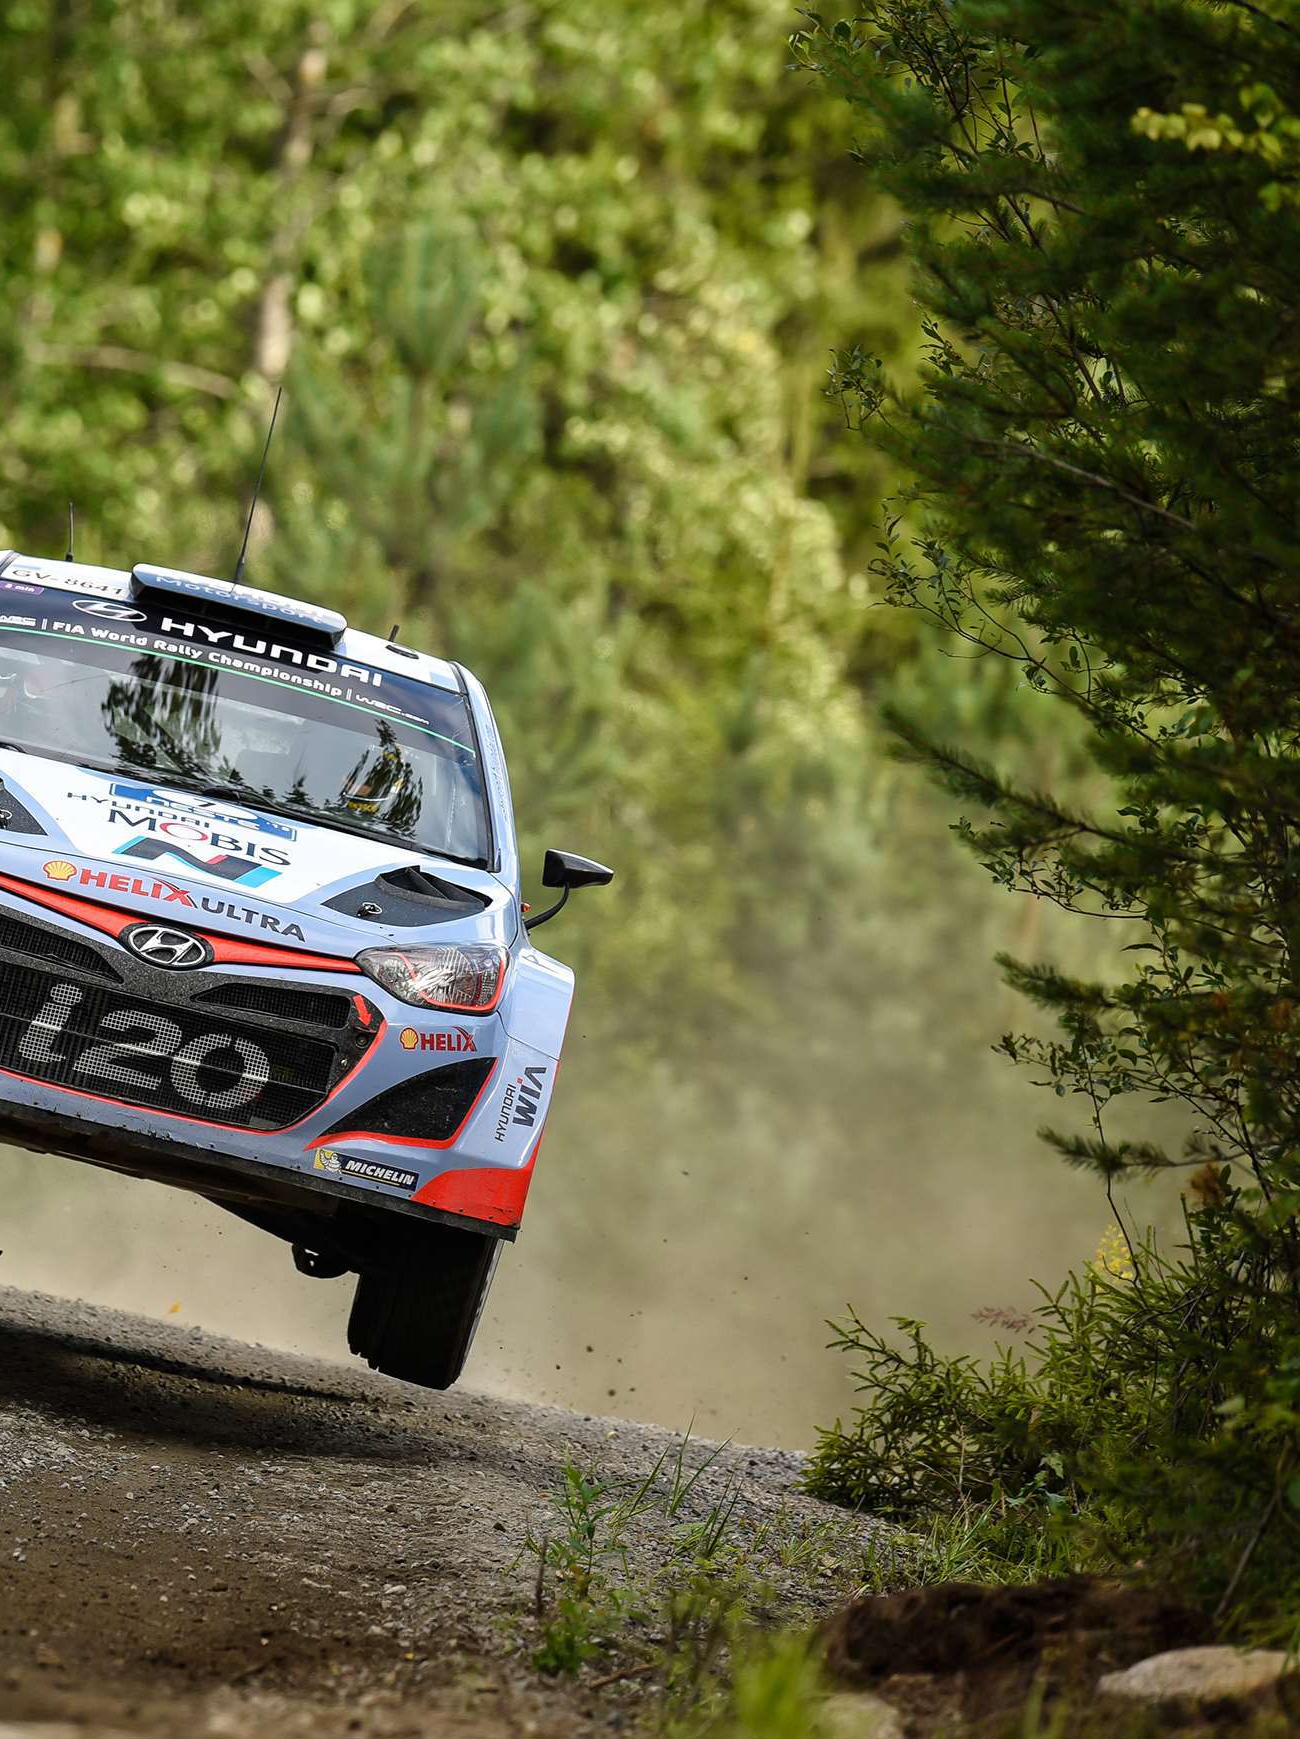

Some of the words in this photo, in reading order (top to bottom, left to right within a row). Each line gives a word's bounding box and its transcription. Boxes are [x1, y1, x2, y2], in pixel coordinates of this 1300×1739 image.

[52, 621, 85, 635] FIA
[90, 626, 148, 646] World
[153, 639, 204, 659] Rally
[208, 651, 342, 697] Championship
[161, 617, 382, 687] HYUNDAI
[67, 791, 210, 829] HYUNDAI
[108, 808, 292, 866] MOBIS
[79, 868, 198, 909] HELIX
[201, 896, 306, 943] ULTRA
[18, 983, 270, 1110] i20
[419, 1026, 477, 1052] HELIX
[494, 1083, 517, 1143] HYUNDAI
[512, 1066, 547, 1127] WIA
[345, 1160, 416, 1186] MICHELIN
